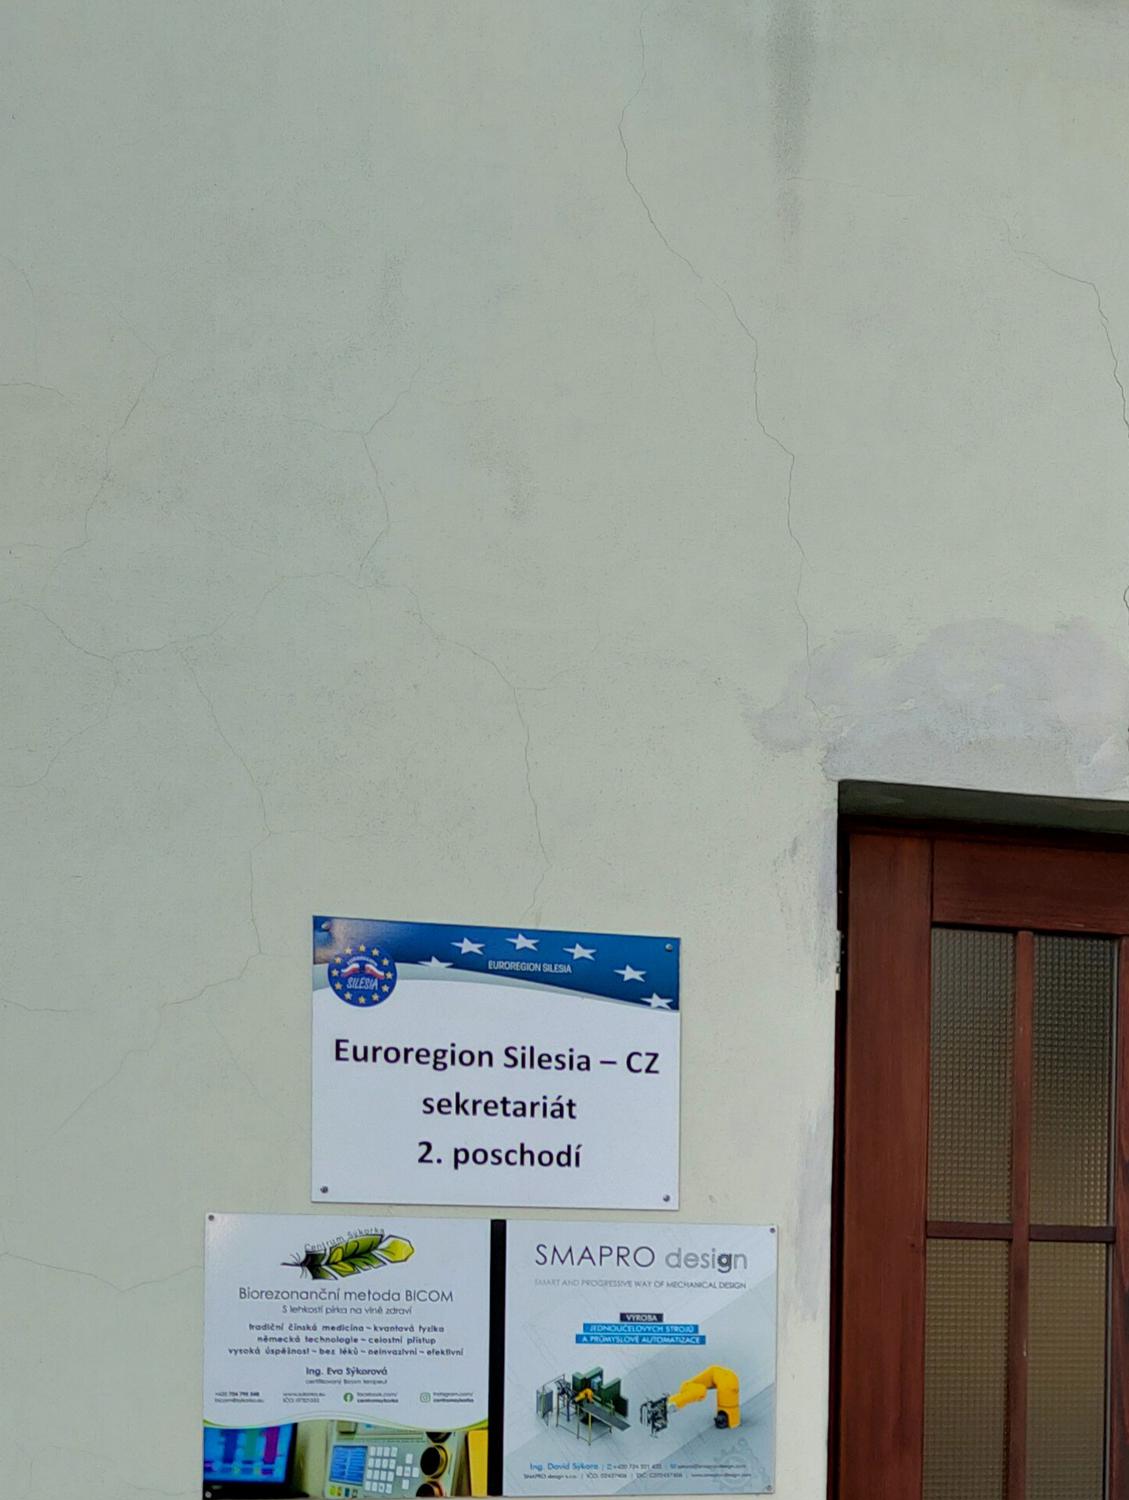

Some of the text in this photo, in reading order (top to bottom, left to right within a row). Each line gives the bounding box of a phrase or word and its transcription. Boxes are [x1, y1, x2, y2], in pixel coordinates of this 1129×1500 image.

[488, 960, 572, 974] EUROREGION SILESIA
[334, 1038, 494, 1071] Euroregion
[503, 1045, 591, 1072] Silesia
[626, 1051, 660, 1075] CZ
[421, 1091, 577, 1120] sekretariát
[417, 1141, 583, 1170] 2. poschodí
[535, 1243, 748, 1274] SMAPRO design
[239, 1287, 454, 1302] Biorezonanční metoda BICOM
[562, 1279, 580, 1287] AND
[581, 1279, 633, 1288] PROGRESSIVE
[654, 1281, 664, 1289] OF
[666, 1281, 717, 1289] MECHANICAL
[719, 1282, 747, 1290] DESIGN
[305, 1367, 324, 1377] Ing.
[326, 1367, 343, 1375] Eva
